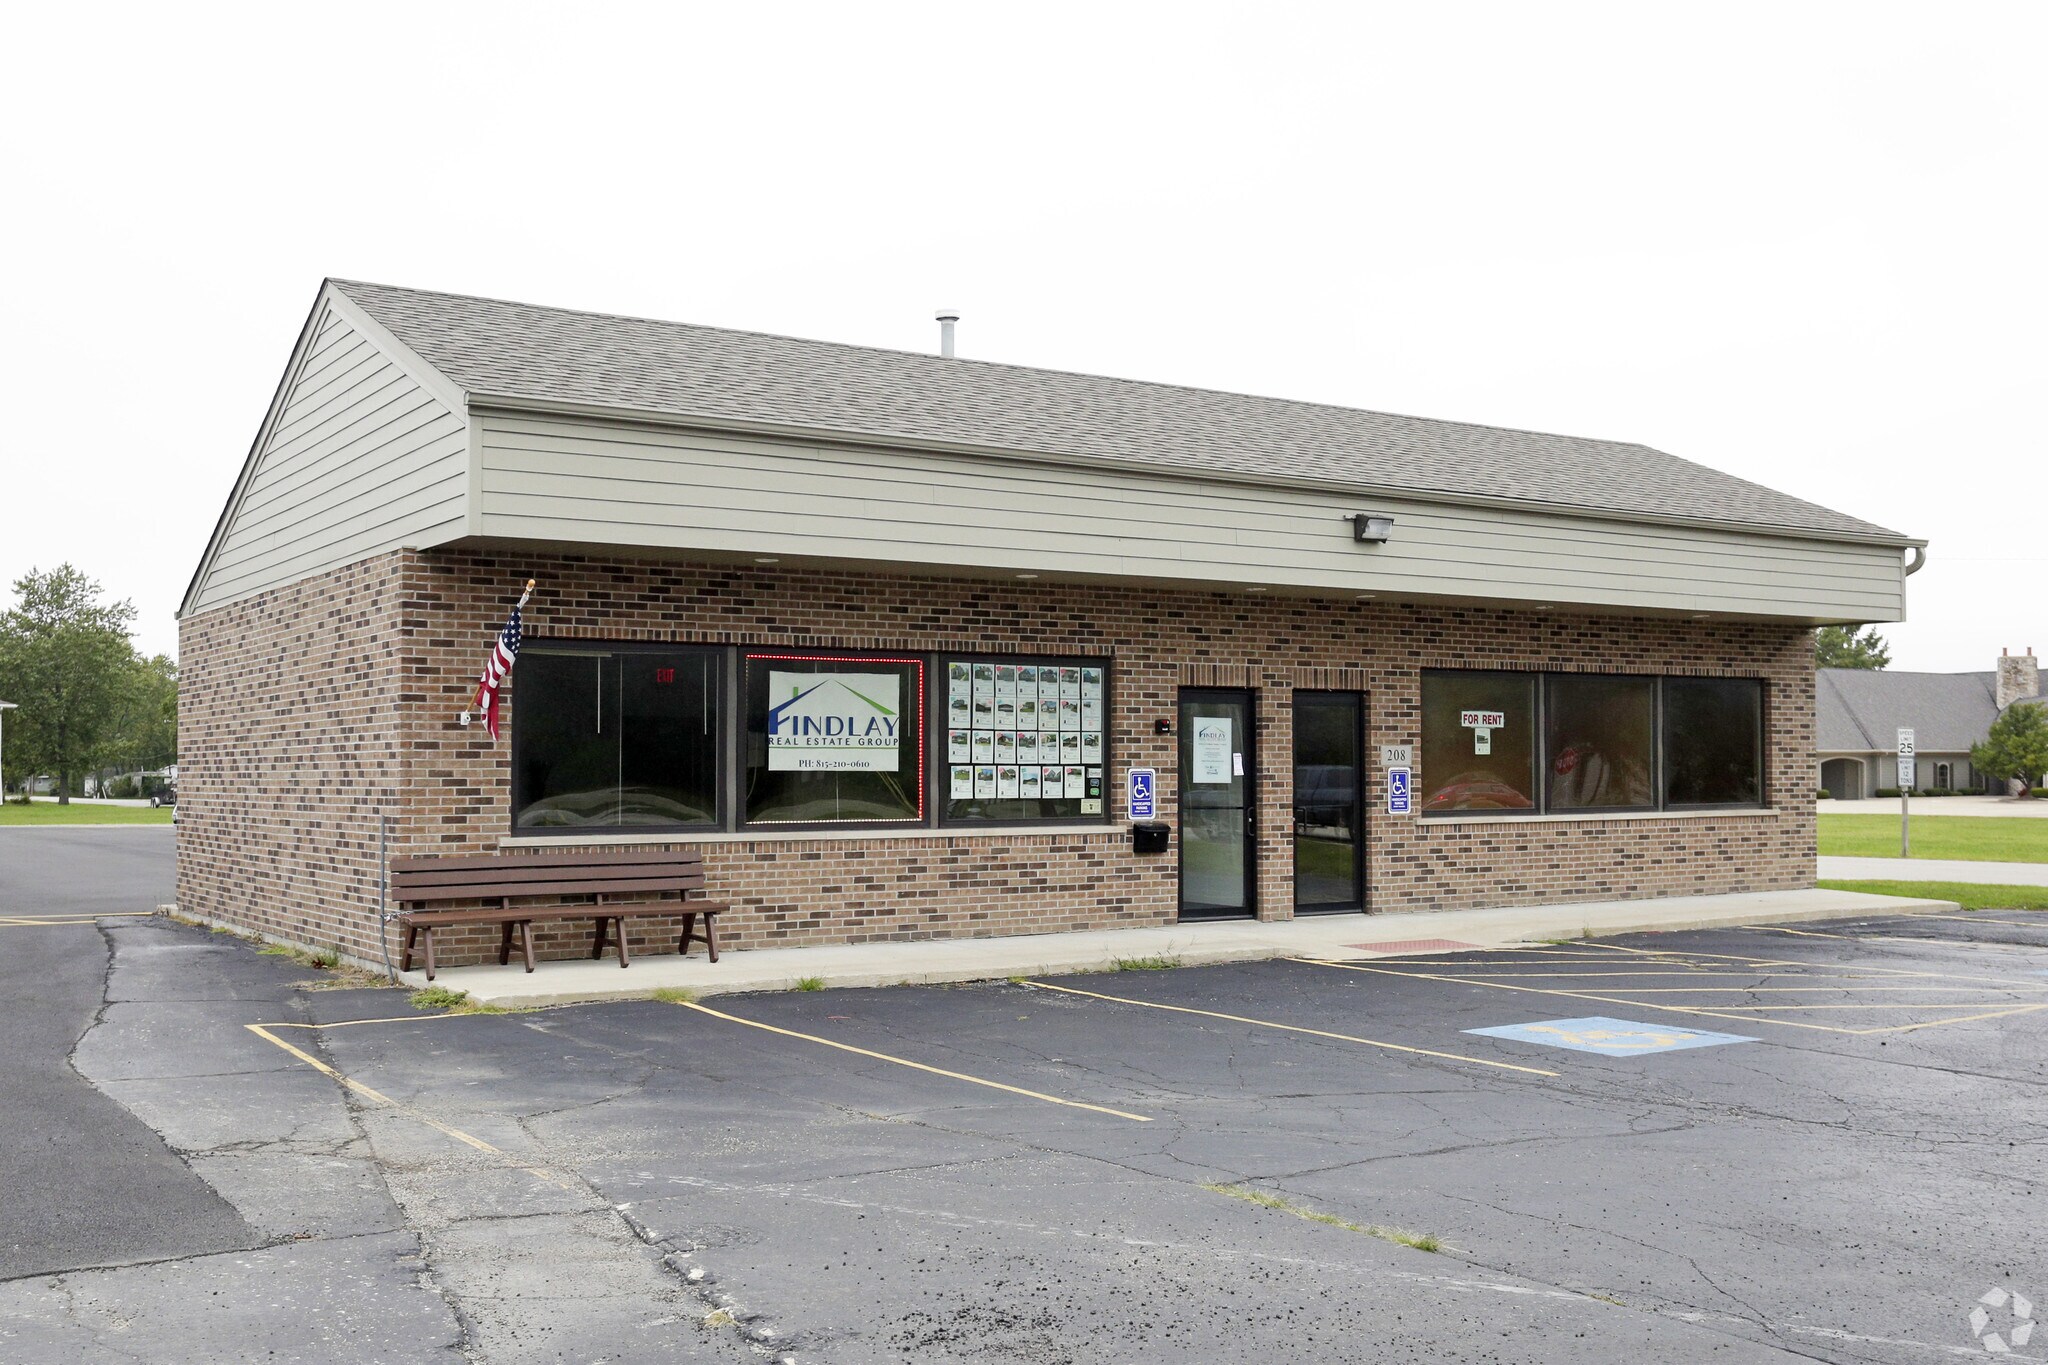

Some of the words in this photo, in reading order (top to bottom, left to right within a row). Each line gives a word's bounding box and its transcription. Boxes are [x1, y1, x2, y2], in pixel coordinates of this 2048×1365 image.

[657, 668, 674, 683] EXIT
[769, 711, 899, 737] FINDLAY
[1463, 713, 1479, 725] FOR
[1482, 714, 1503, 725] RENT
[769, 737, 799, 746] REAL
[806, 737, 851, 746] ESTATE
[858, 738, 899, 746] GROUP
[1900, 742, 1913, 754] 25
[1387, 749, 1406, 761] 208
[798, 759, 814, 768] PH:
[816, 759, 870, 769] 815-210-0610
